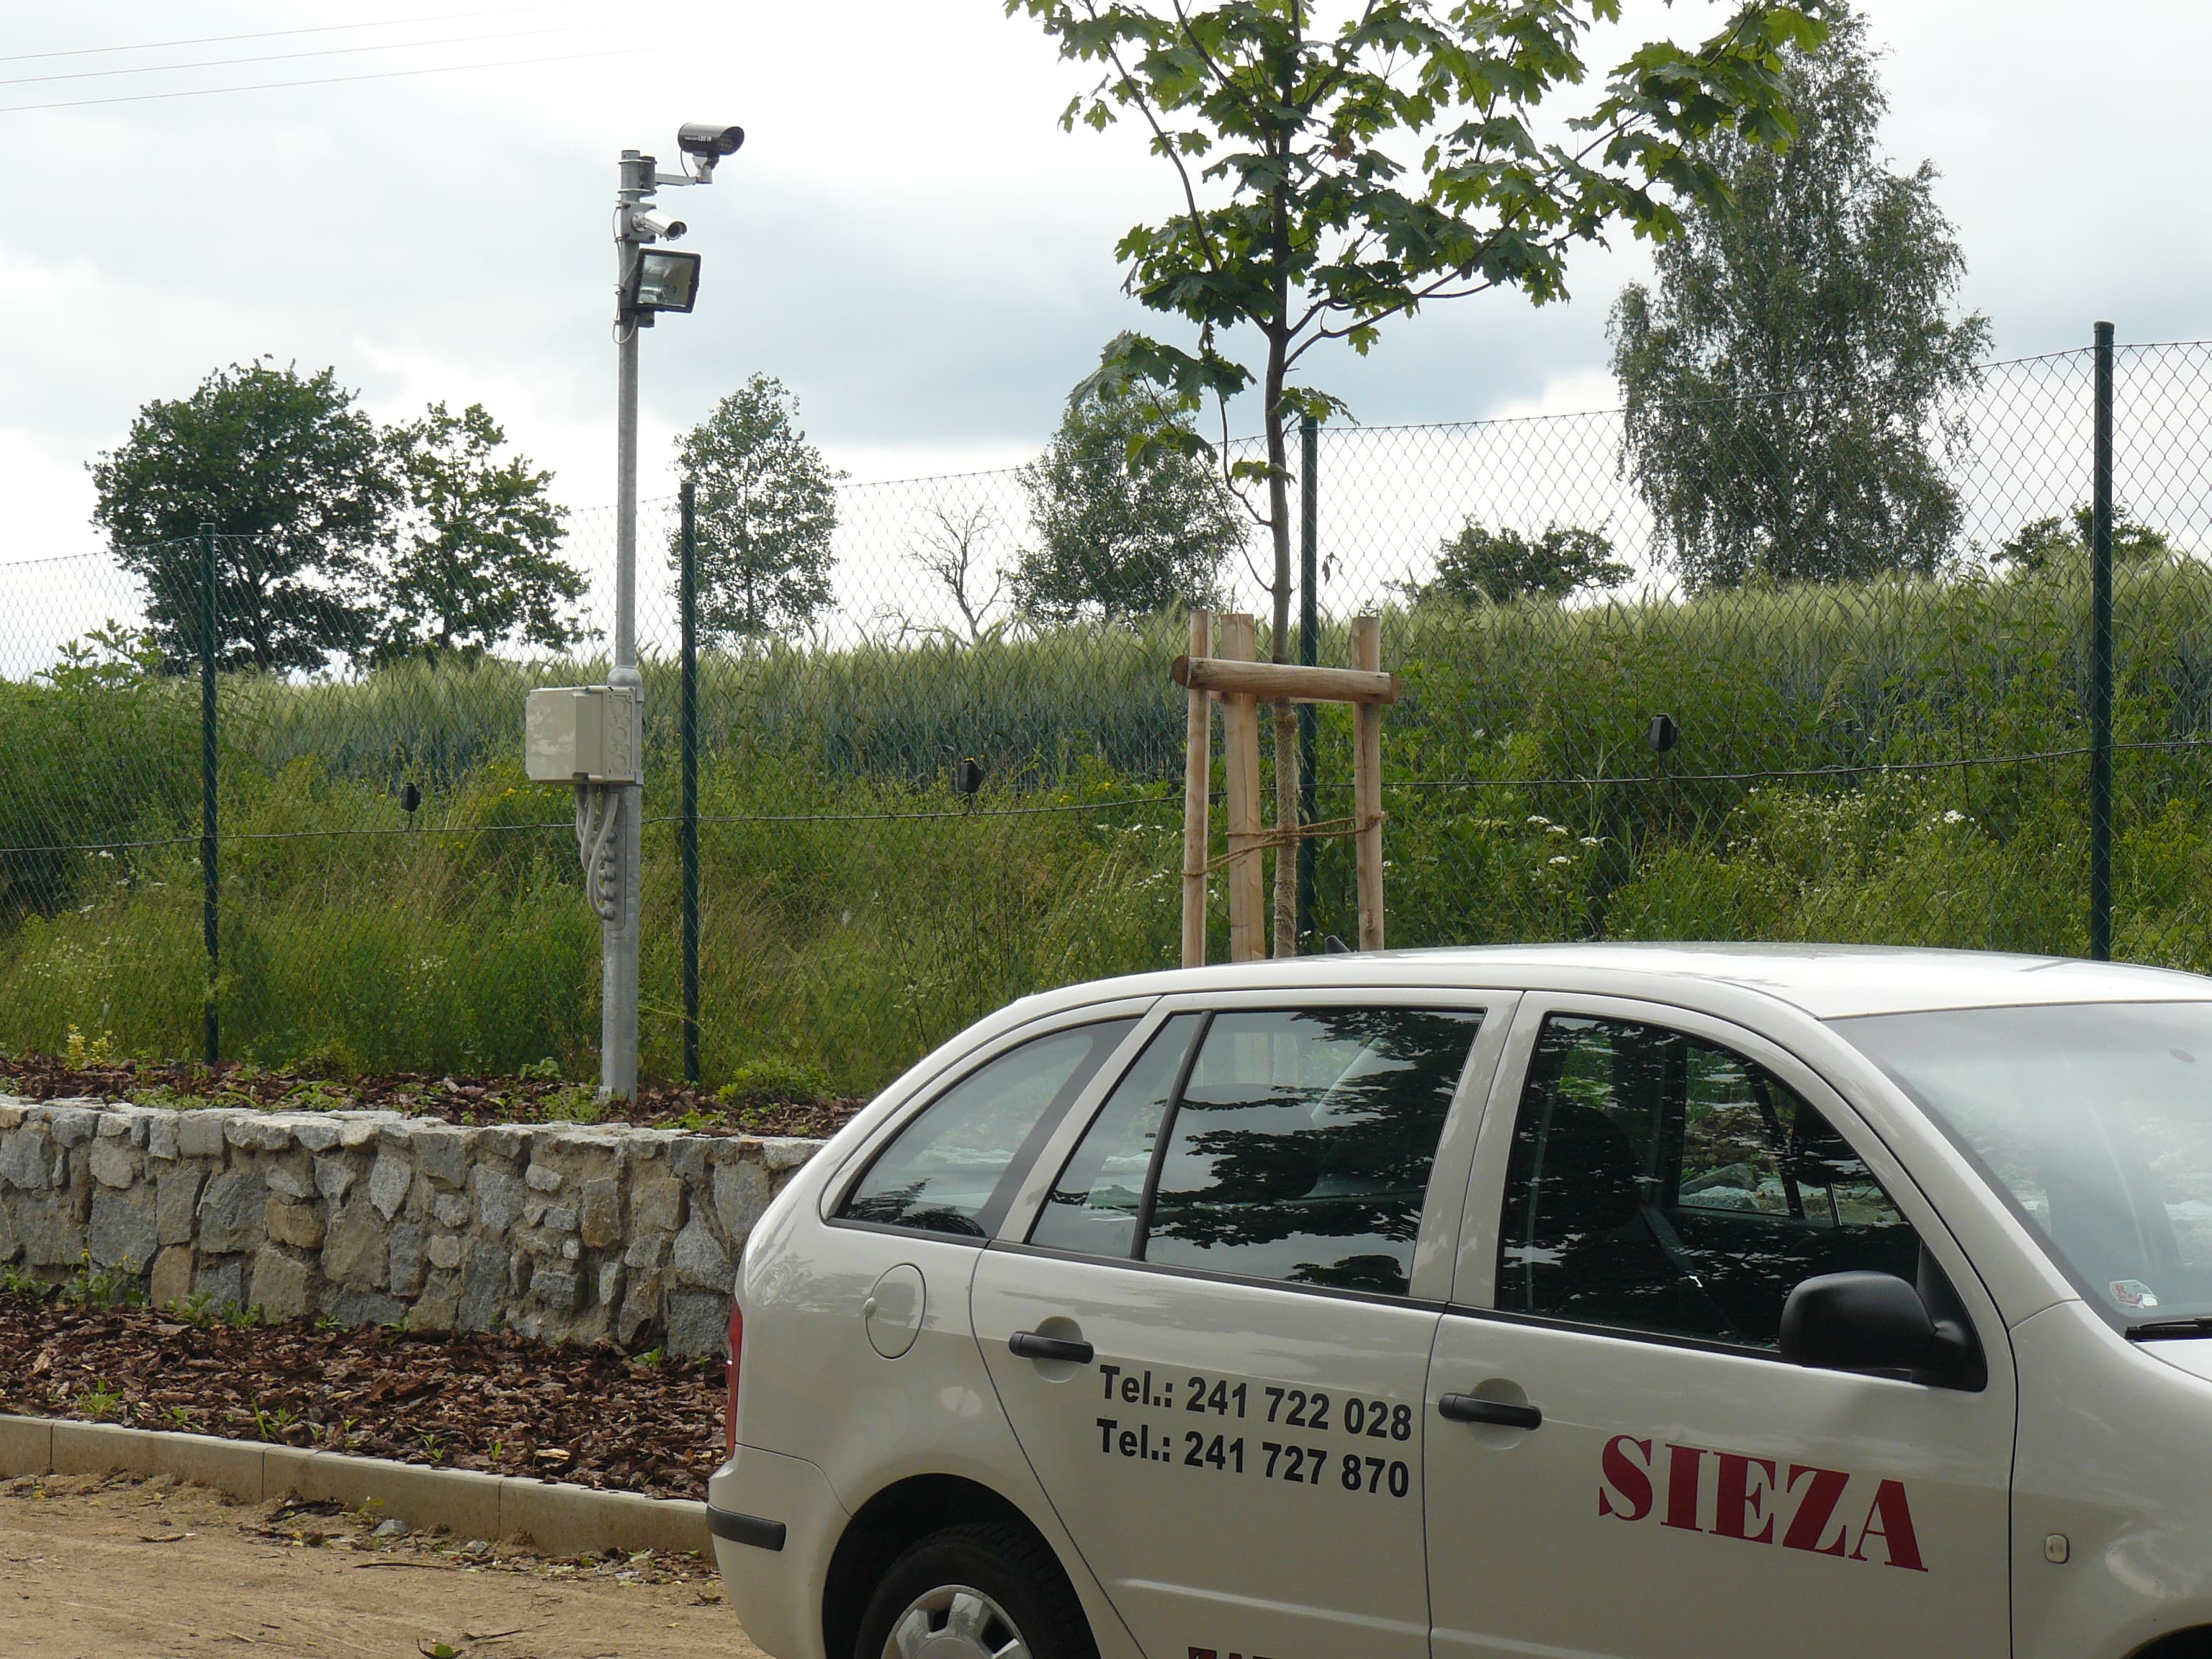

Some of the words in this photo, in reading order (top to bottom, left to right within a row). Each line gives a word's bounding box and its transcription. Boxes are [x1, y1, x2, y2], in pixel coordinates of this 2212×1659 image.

[1099, 1364, 1173, 1408] Tel.:
[1185, 1376, 1247, 1419] 241
[1265, 1386, 1330, 1430] 722
[1344, 1398, 1412, 1442] 028
[1096, 1417, 1171, 1463] Tel.:
[1184, 1431, 1244, 1474] 241
[1262, 1441, 1328, 1485] 727
[1341, 1454, 1409, 1498] 870
[1599, 1434, 1930, 1573] SIEZA
